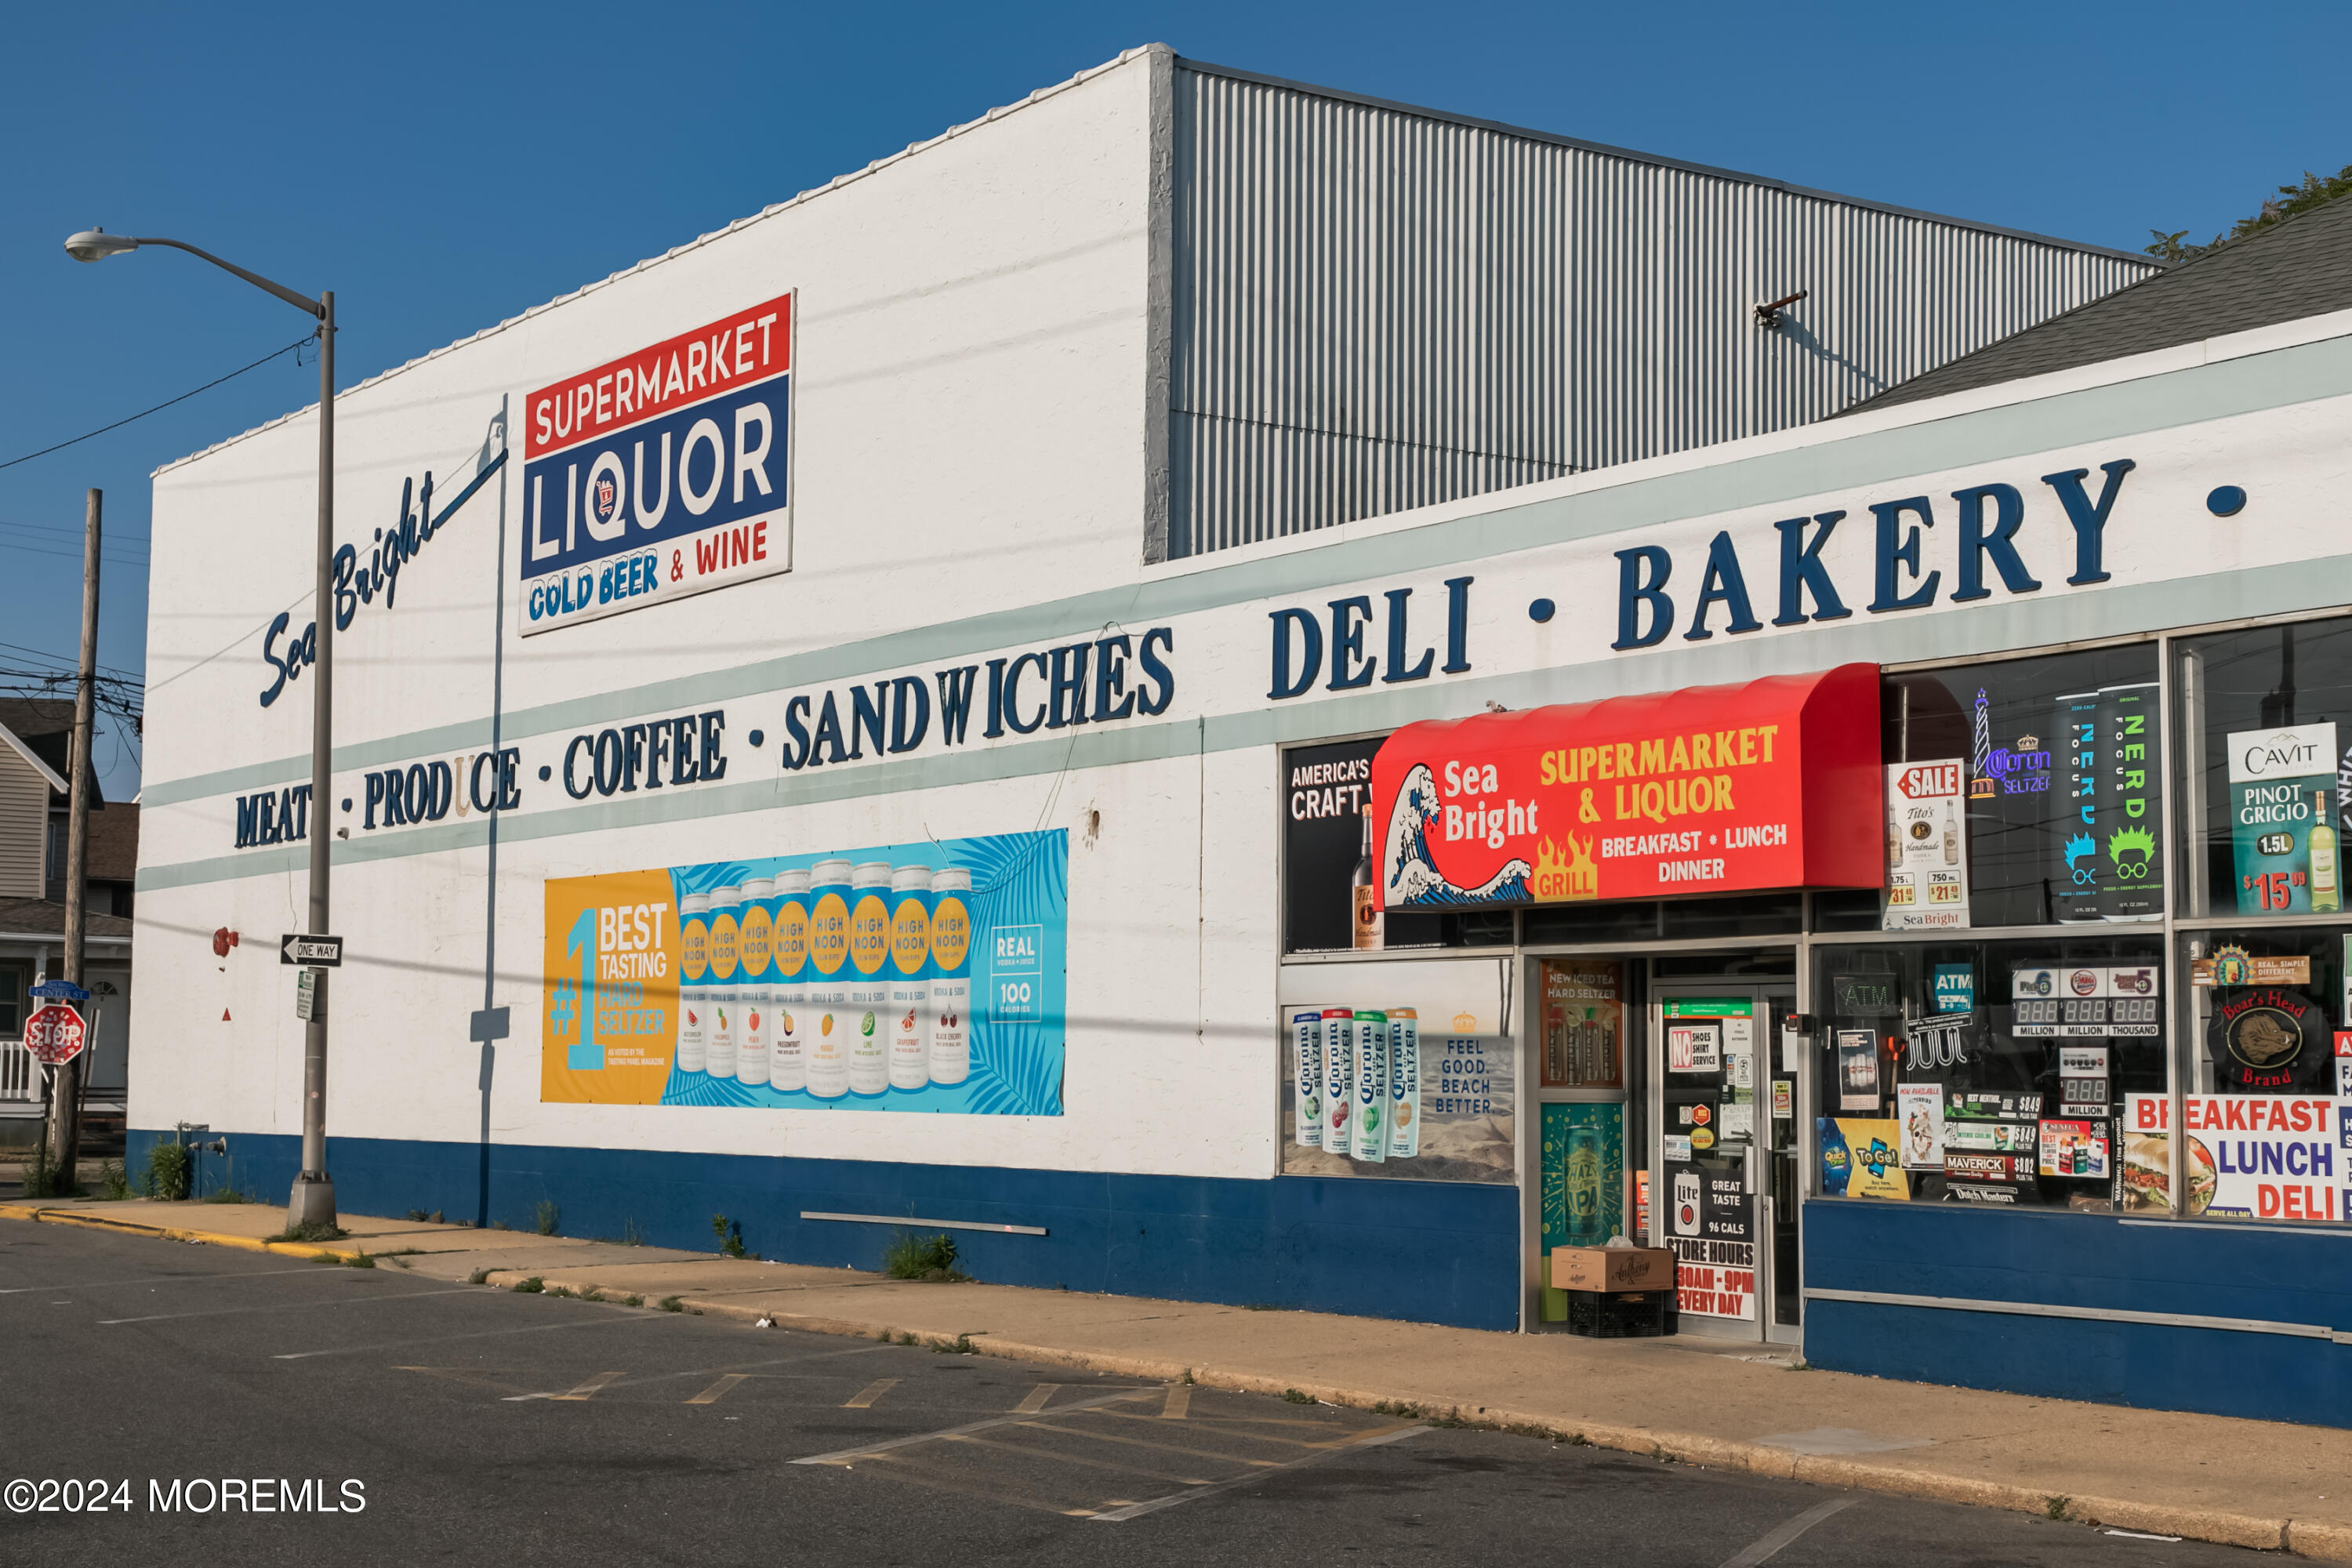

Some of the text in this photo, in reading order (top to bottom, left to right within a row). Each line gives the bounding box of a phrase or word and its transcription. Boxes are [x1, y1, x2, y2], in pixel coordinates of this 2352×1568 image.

[535, 312, 777, 445] SUPERMARKET
[532, 401, 773, 562] LIQUOR
[528, 521, 767, 621] COLD BEER & WINE
[260, 470, 436, 708] Sea Bright
[234, 458, 2137, 849] MEAT PRODUCE COFFEE SANDWICHES DELI BAKERY
[1540, 724, 1779, 786] SUPERMARKET
[2115, 717, 2124, 791] FOCUS
[2245, 743, 2319, 775] CAVIT
[1291, 758, 1370, 788] AMERICA'S
[1985, 749, 2050, 782] Coron
[2125, 715, 2146, 818] NERD
[1444, 760, 1499, 798] Sea
[1907, 766, 1956, 797] SALE
[1291, 784, 1363, 821] CRAFT
[1578, 773, 1736, 825] & LIQUOR
[2245, 784, 2302, 805] PINOT
[1907, 807, 1934, 820] Tito's
[2240, 802, 2309, 824] GRIGIO
[1445, 798, 1538, 849] Bright
[1601, 823, 1787, 858] BREAKFAST LUNCH
[1905, 840, 1940, 852] Handmade
[2260, 835, 2288, 853] 1.5L
[1658, 858, 1726, 883] DINNER
[1933, 873, 1947, 882] 750
[2291, 872, 2307, 886] 99
[1538, 871, 1594, 897] GRILL
[601, 902, 668, 952] BEST
[816, 916, 844, 931] HIGH
[856, 918, 884, 932] HIGH
[898, 920, 924, 933] HIGH
[938, 918, 964, 931] HIGH
[1904, 913, 1958, 926] Sea Bright
[297, 942, 336, 957] ONE WAY
[815, 935, 844, 949] NOON
[855, 936, 884, 949] NOON
[895, 937, 925, 949] NOON
[936, 935, 964, 947] NOON
[996, 937, 1035, 957] REAL
[601, 952, 667, 979] TASTING
[1549, 974, 1615, 985] NEW ICED TEA
[1936, 974, 1973, 989] ATM
[34, 989, 71, 998] CENTER
[598, 981, 644, 1008] HARD
[1000, 982, 1031, 1004] 100
[1548, 988, 1616, 999] HARD SELTZER
[1845, 985, 1888, 1007] ATM
[2222, 990, 2307, 1021] Boar's Head
[598, 1009, 665, 1036] SELTZER
[2020, 1026, 2055, 1036] MILLION
[2067, 1026, 2103, 1035] MILLION
[2112, 1025, 2156, 1035] THOUSAND
[31, 1021, 82, 1047] STOP
[1693, 1033, 1711, 1042] SHOES
[1447, 1040, 1483, 1054] FEEL
[1672, 1031, 1692, 1068] NO
[1693, 1044, 1709, 1054] SHIRT
[1906, 1026, 1967, 1072] JUUL
[1329, 1022, 1344, 1098] Corona
[1341, 1029, 1352, 1091] SELTZER
[1359, 1024, 1376, 1105] Corona
[1375, 1033, 1384, 1098] SELTZER
[1392, 1021, 1407, 1100] Corona
[1405, 1029, 1415, 1093] SELTZER
[1442, 1059, 1490, 1074] GOOD.
[1693, 1055, 1715, 1065] SERVICE
[1442, 1079, 1490, 1094] BEACH
[2242, 1068, 2292, 1087] Brand
[1436, 1098, 1495, 1113] BETTER.
[1966, 1094, 1980, 1102] BEST
[2019, 1096, 2041, 1112] $8.49
[2068, 1105, 2103, 1115] MILLION
[2015, 1127, 2036, 1142] $8.49
[2042, 1134, 2056, 1143] BEST
[1857, 1149, 1897, 1164] To Go!
[1947, 1157, 2002, 1171] MAVERICK
[2014, 1157, 2034, 1174] $8.02
[2219, 1140, 2332, 1177] LUNCH
[1568, 1164, 1598, 1181] HAZY
[1677, 1185, 1698, 1203] Lite
[1711, 1180, 1741, 1192] GREAT
[1568, 1185, 1598, 1214] IPA
[1712, 1194, 1740, 1206] TASTE
[1955, 1189, 1982, 1200] Dutch
[1980, 1189, 2015, 1203] Masters
[2257, 1184, 2334, 1221] DELI
[1709, 1221, 1744, 1234] 96 CALS
[1666, 1238, 1754, 1266] STORE HOURS
[1725, 1270, 1754, 1294] 9PM
[1676, 1290, 1743, 1316] EVERY DAY
